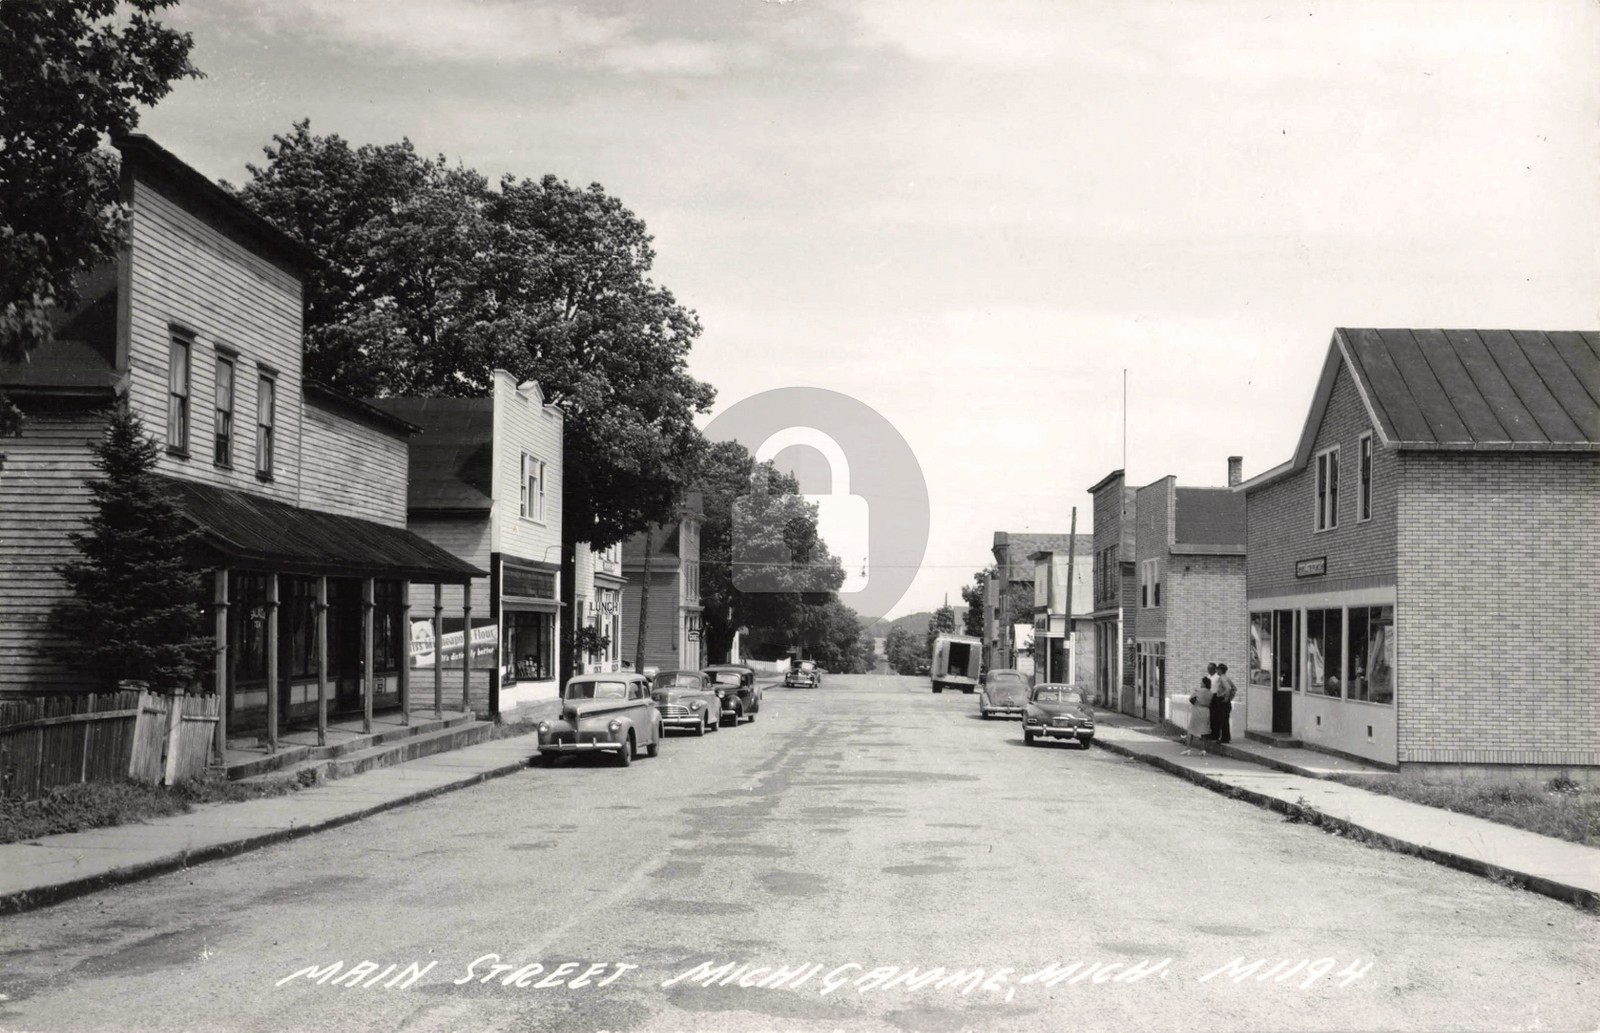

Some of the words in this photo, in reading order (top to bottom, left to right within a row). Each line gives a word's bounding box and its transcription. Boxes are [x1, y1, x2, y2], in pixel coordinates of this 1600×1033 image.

[589, 601, 618, 612] LUNCH
[474, 628, 496, 641] Flour
[477, 647, 495, 656] better
